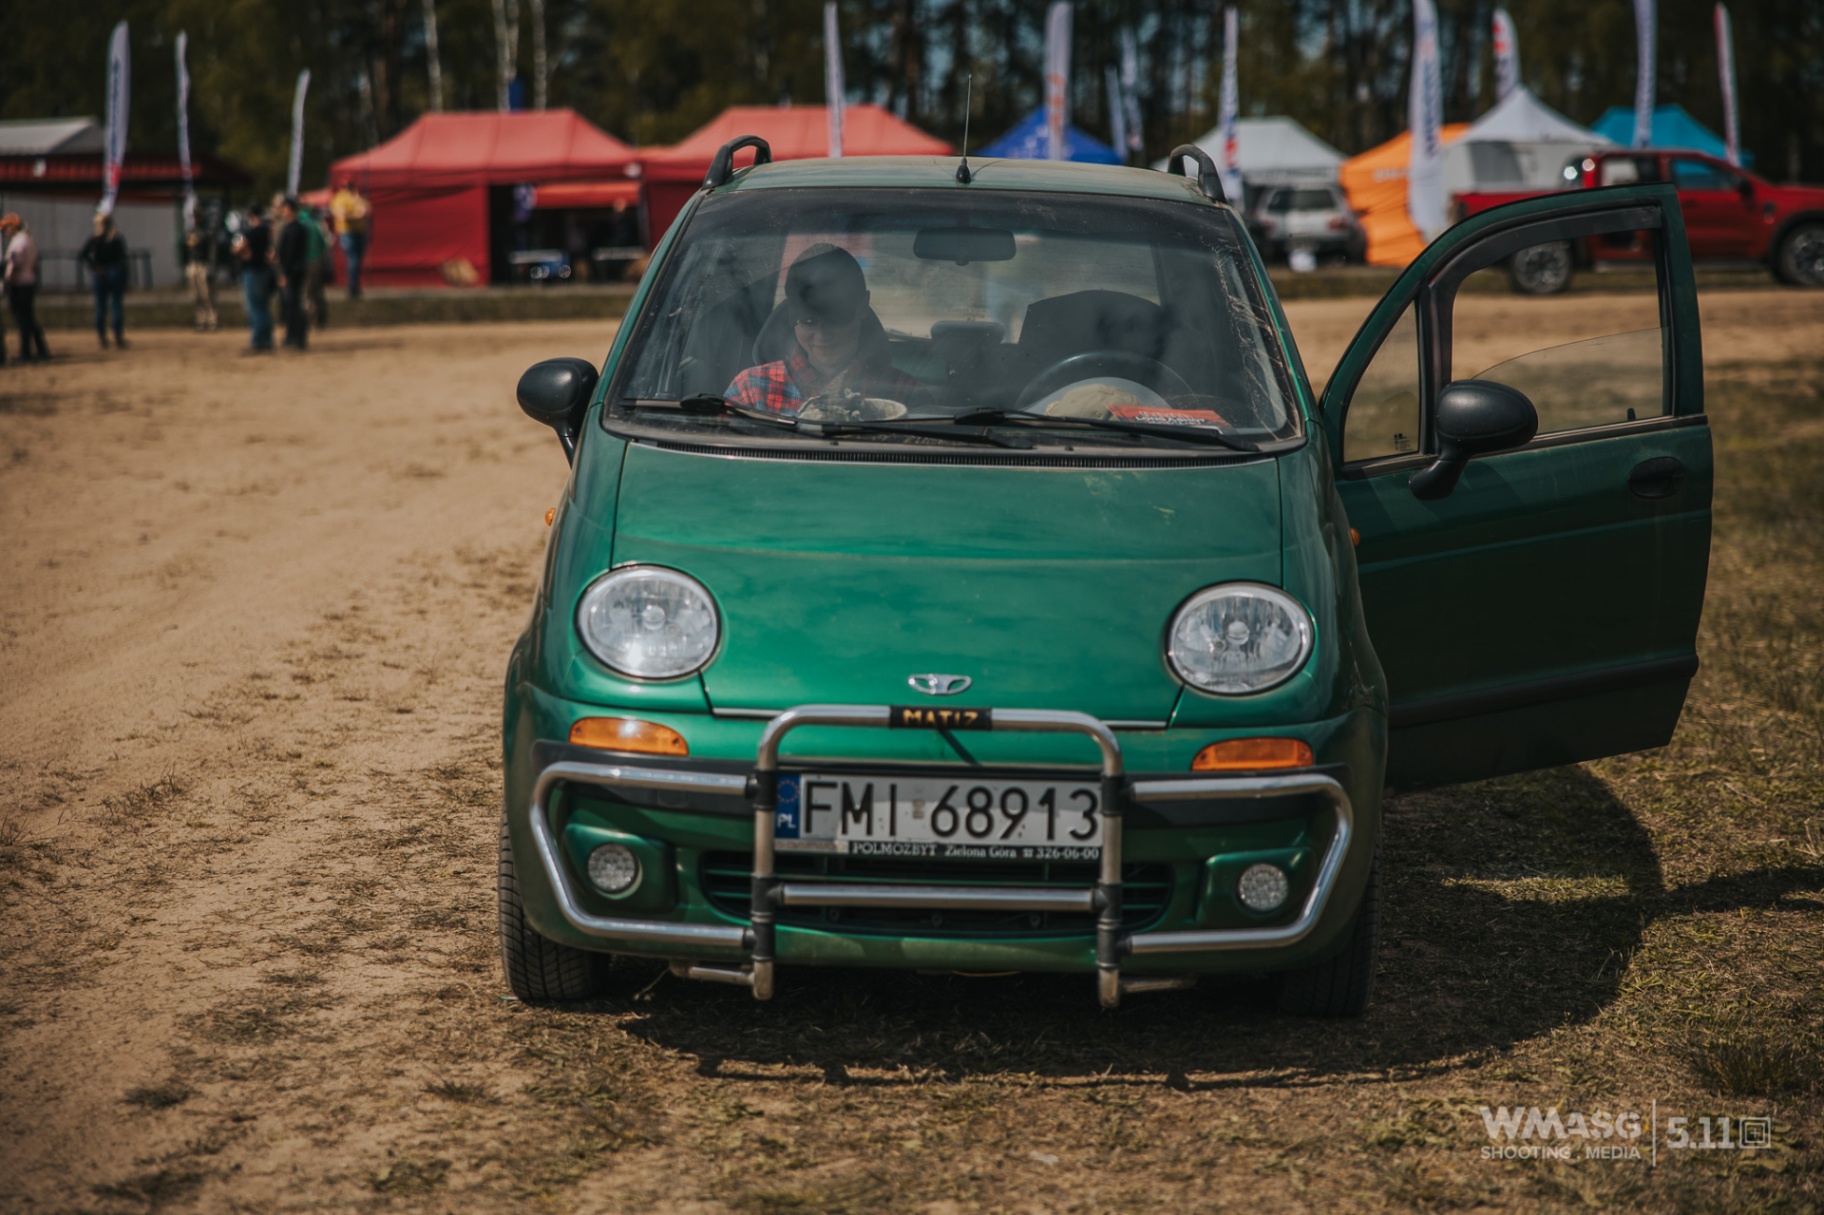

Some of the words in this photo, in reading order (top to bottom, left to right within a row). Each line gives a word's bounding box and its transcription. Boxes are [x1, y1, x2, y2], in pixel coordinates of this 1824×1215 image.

[902, 709, 978, 726] MATIZ
[805, 780, 897, 837] FMI
[931, 784, 1099, 842] 68913
[777, 813, 797, 829] PL
[852, 842, 938, 857] POLMOZBYT
[944, 844, 986, 857] Zielona
[990, 845, 1017, 859] Góra
[1036, 846, 1100, 860] 326-06-00
